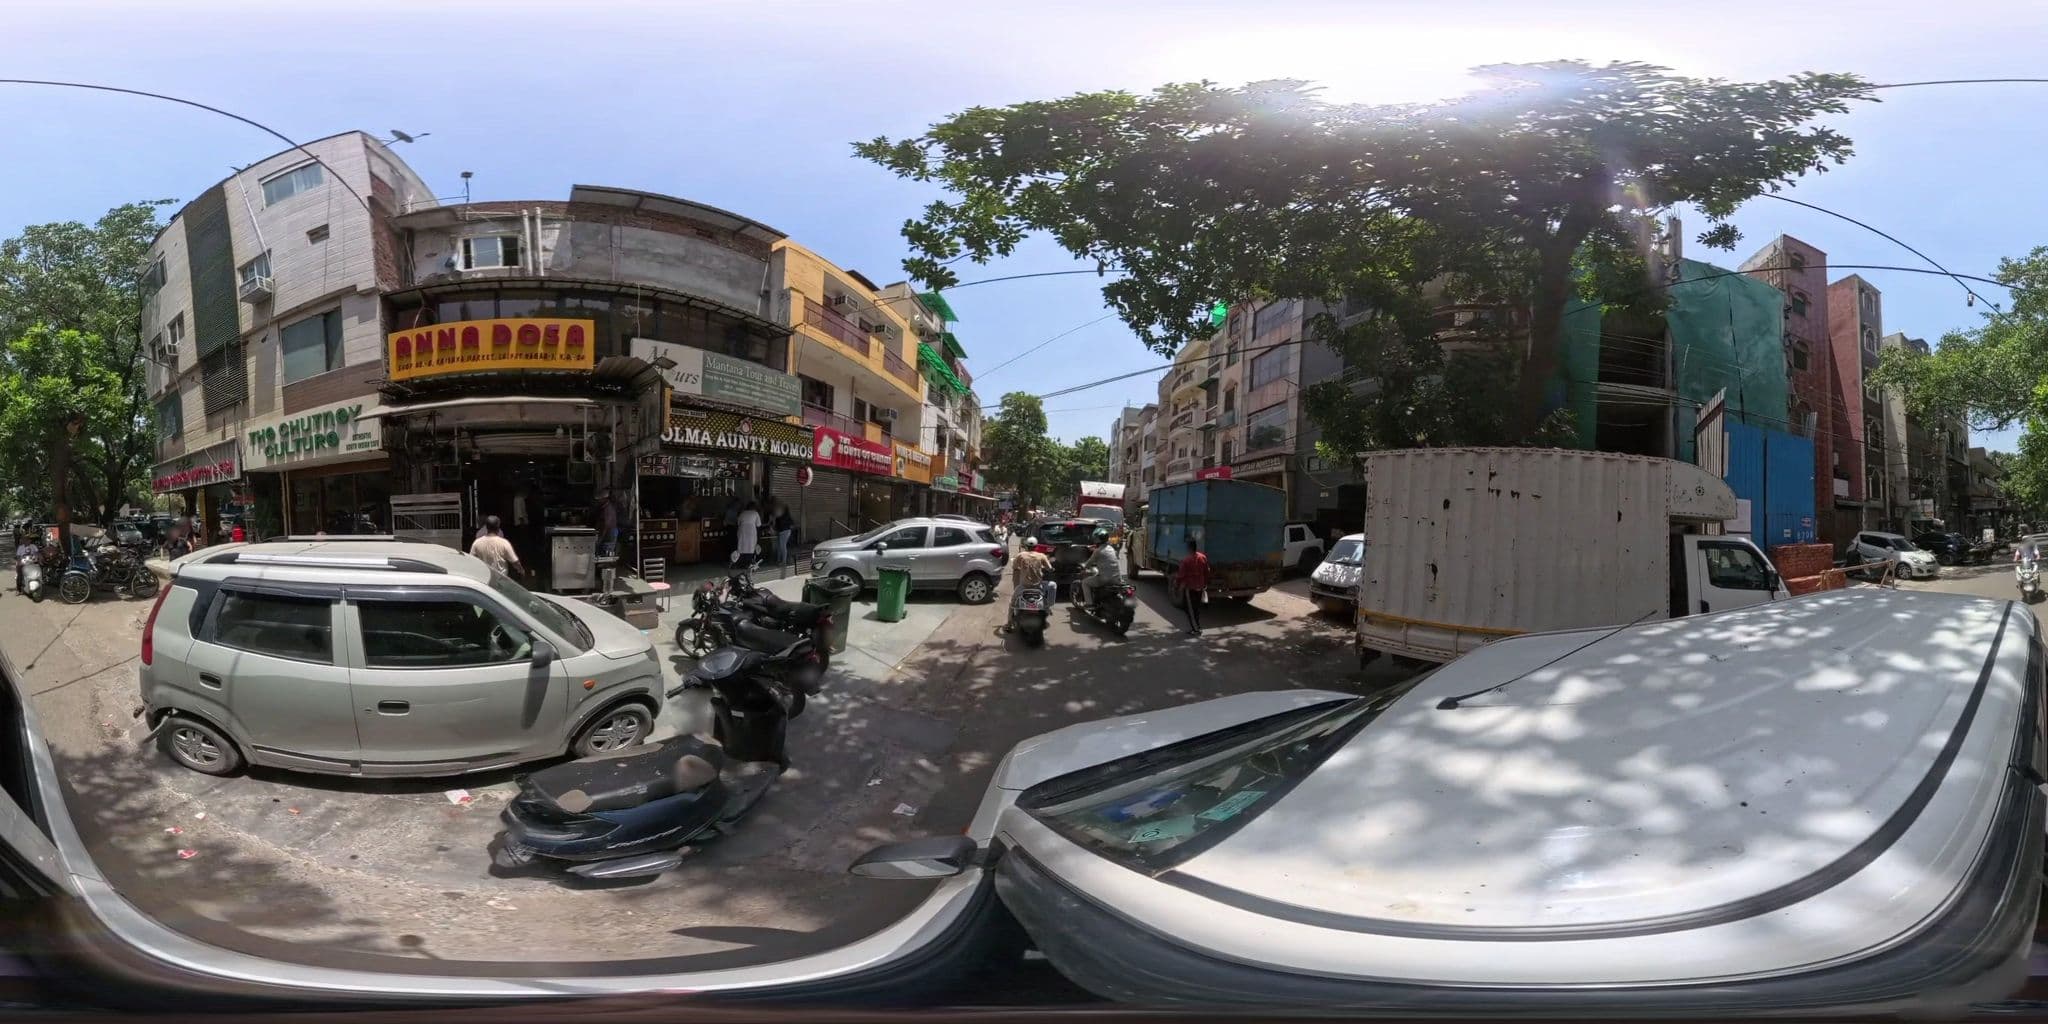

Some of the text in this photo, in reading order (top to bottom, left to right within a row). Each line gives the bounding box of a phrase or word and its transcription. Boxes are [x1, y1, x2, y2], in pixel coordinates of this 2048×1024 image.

[395, 323, 585, 356] ANNA DOSA
[705, 357, 744, 376] Mantana
[716, 431, 768, 452] AUNTY
[770, 439, 813, 458] MOMOS
